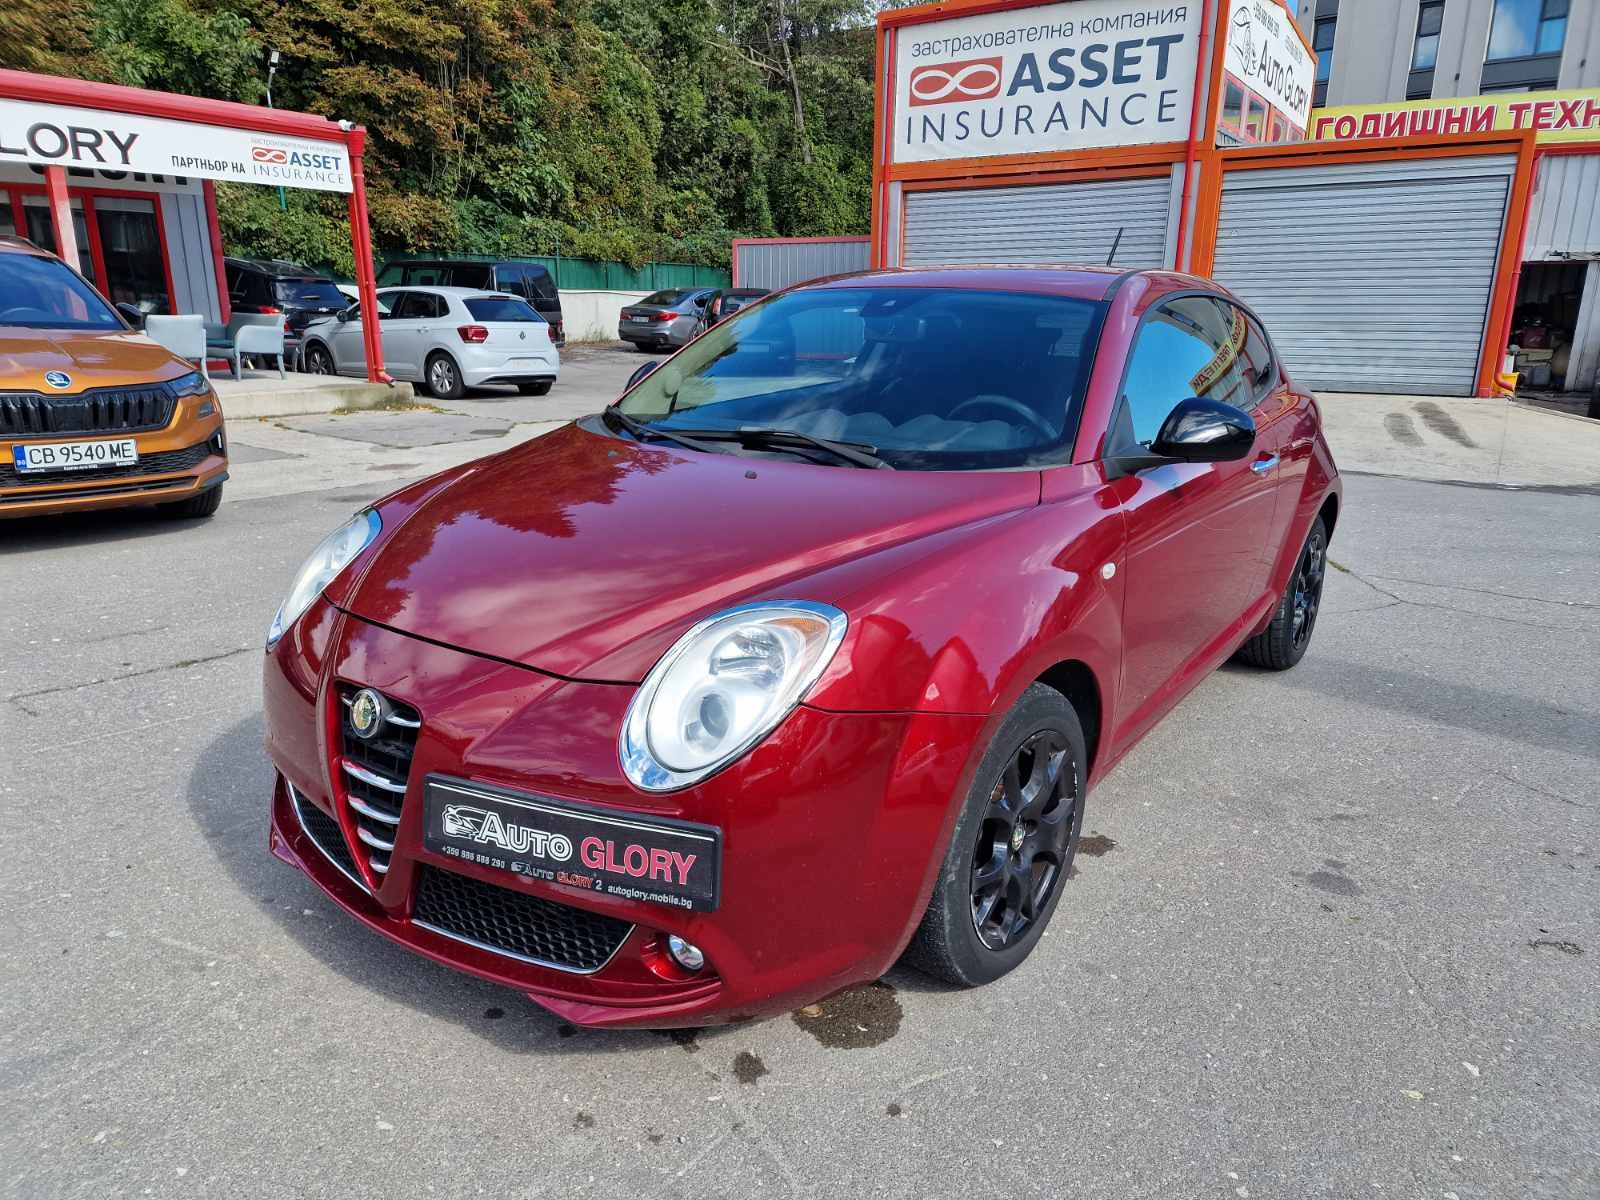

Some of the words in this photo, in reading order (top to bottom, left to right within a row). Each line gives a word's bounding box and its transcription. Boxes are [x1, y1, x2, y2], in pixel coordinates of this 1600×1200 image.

[912, 22, 1074, 57] застрахователна
[1080, 6, 1188, 34] компания
[1006, 33, 1185, 97] ASSET
[1257, 40, 1284, 95] AUTO
[907, 89, 1179, 145] INSURANCE
[1315, 105, 1496, 140] ГОДИШНИ
[171, 155, 229, 173] ПАРТНЬОР
[231, 162, 246, 174] НА
[289, 151, 342, 171] ASSET
[252, 165, 345, 185] INSURANCE
[29, 446, 56, 465] CB
[59, 444, 106, 463] 9540
[109, 442, 134, 460] ME
[441, 845, 460, 857] +359
[474, 812, 573, 862] AUTO
[580, 836, 697, 885] GLORY
[595, 879, 603, 890] 2
[607, 883, 693, 909] autoglory.mobile.bg
